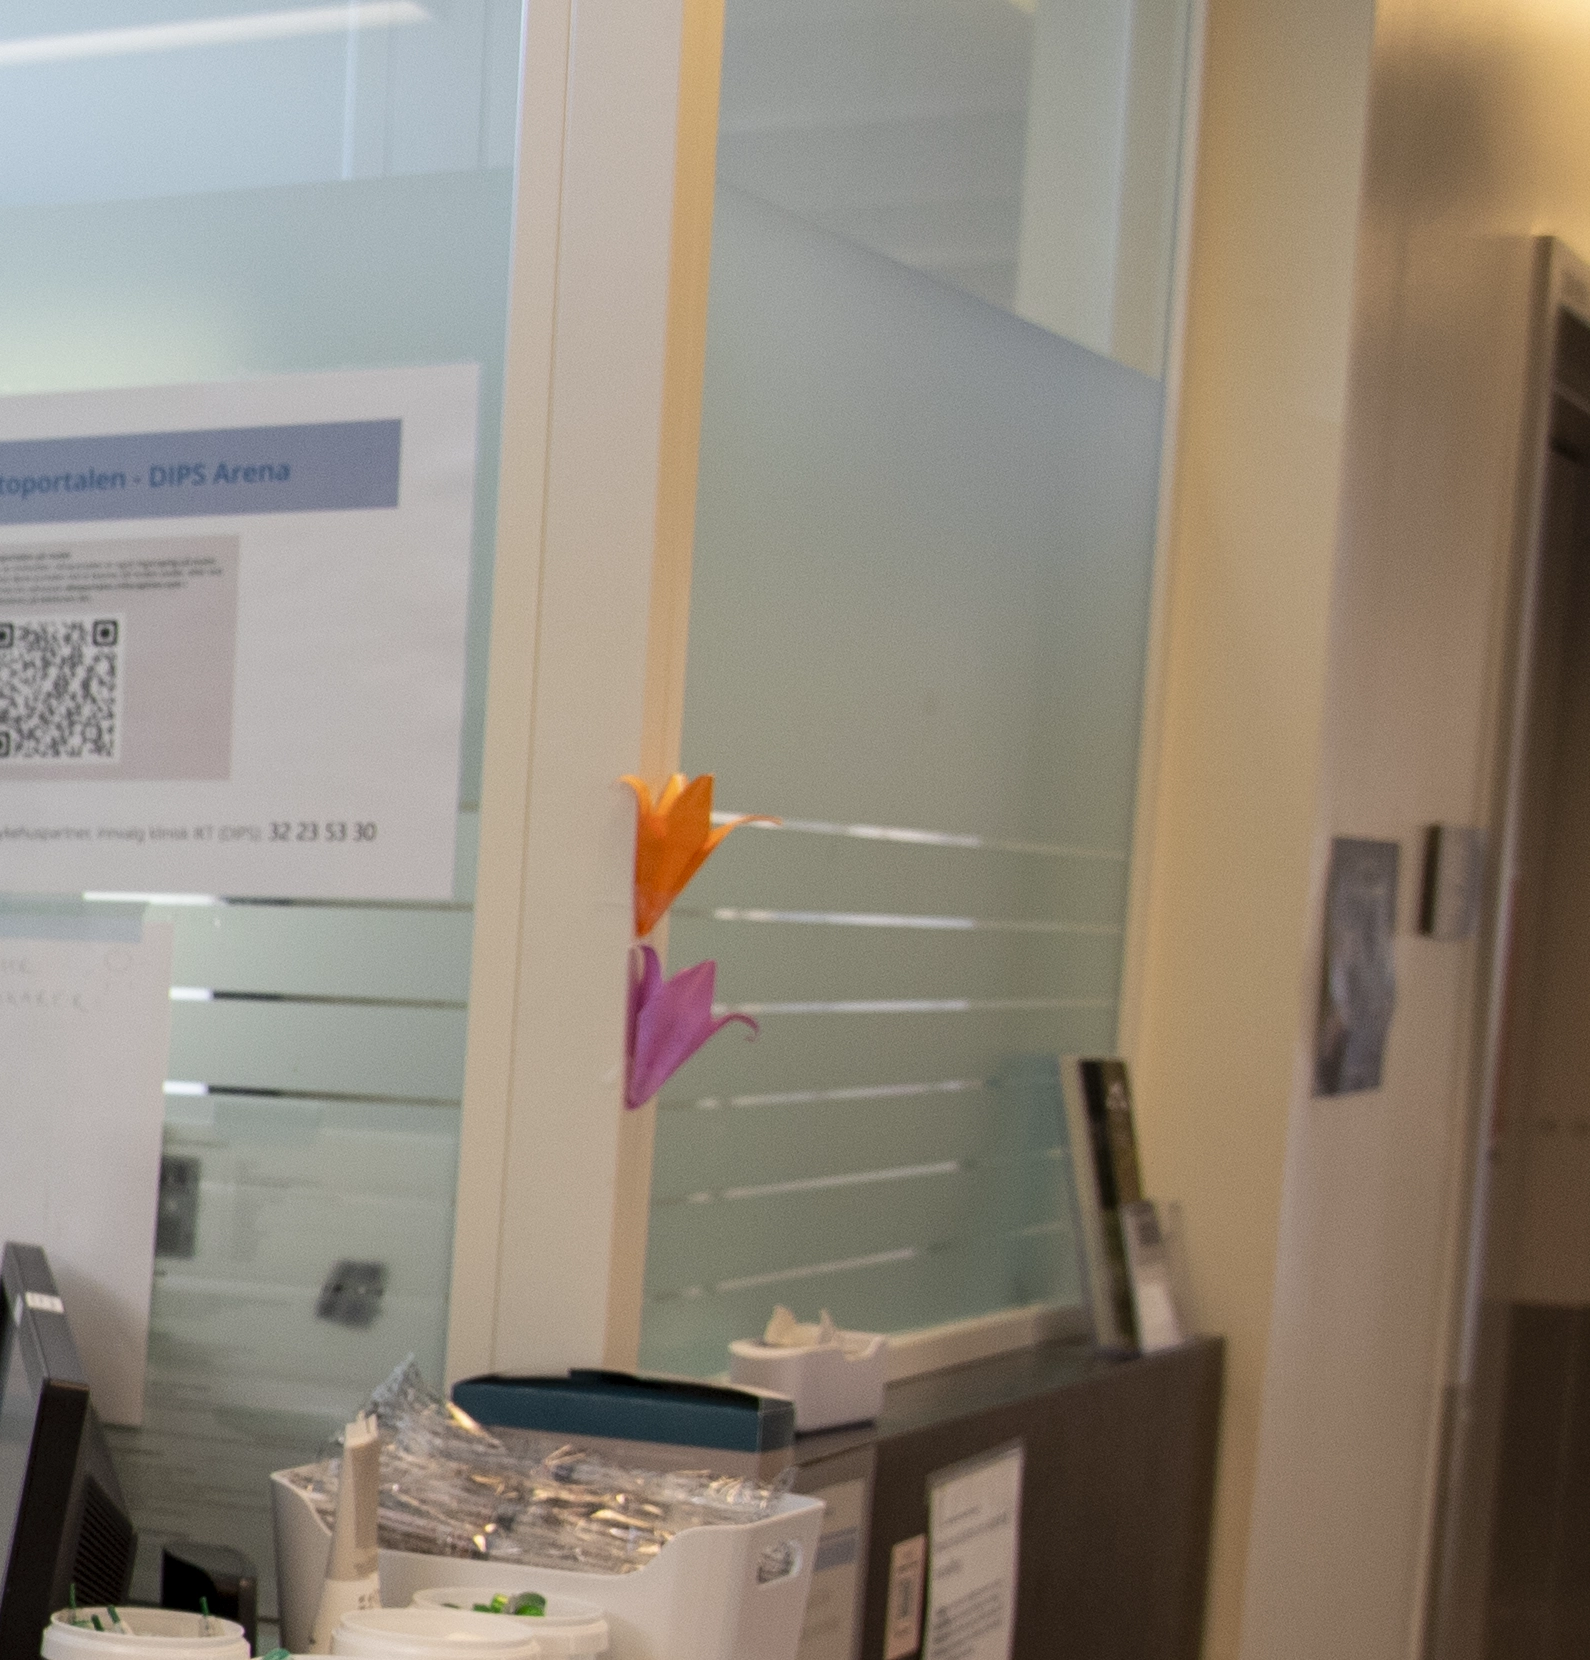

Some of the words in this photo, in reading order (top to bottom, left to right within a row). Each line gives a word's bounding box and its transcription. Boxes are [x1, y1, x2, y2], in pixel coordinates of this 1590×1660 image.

[148, 463, 207, 488] DIPS
[212, 462, 291, 485] Arena
[271, 821, 291, 842] 32
[296, 821, 320, 842] 23
[325, 821, 348, 842] 53
[353, 821, 377, 842] 30
